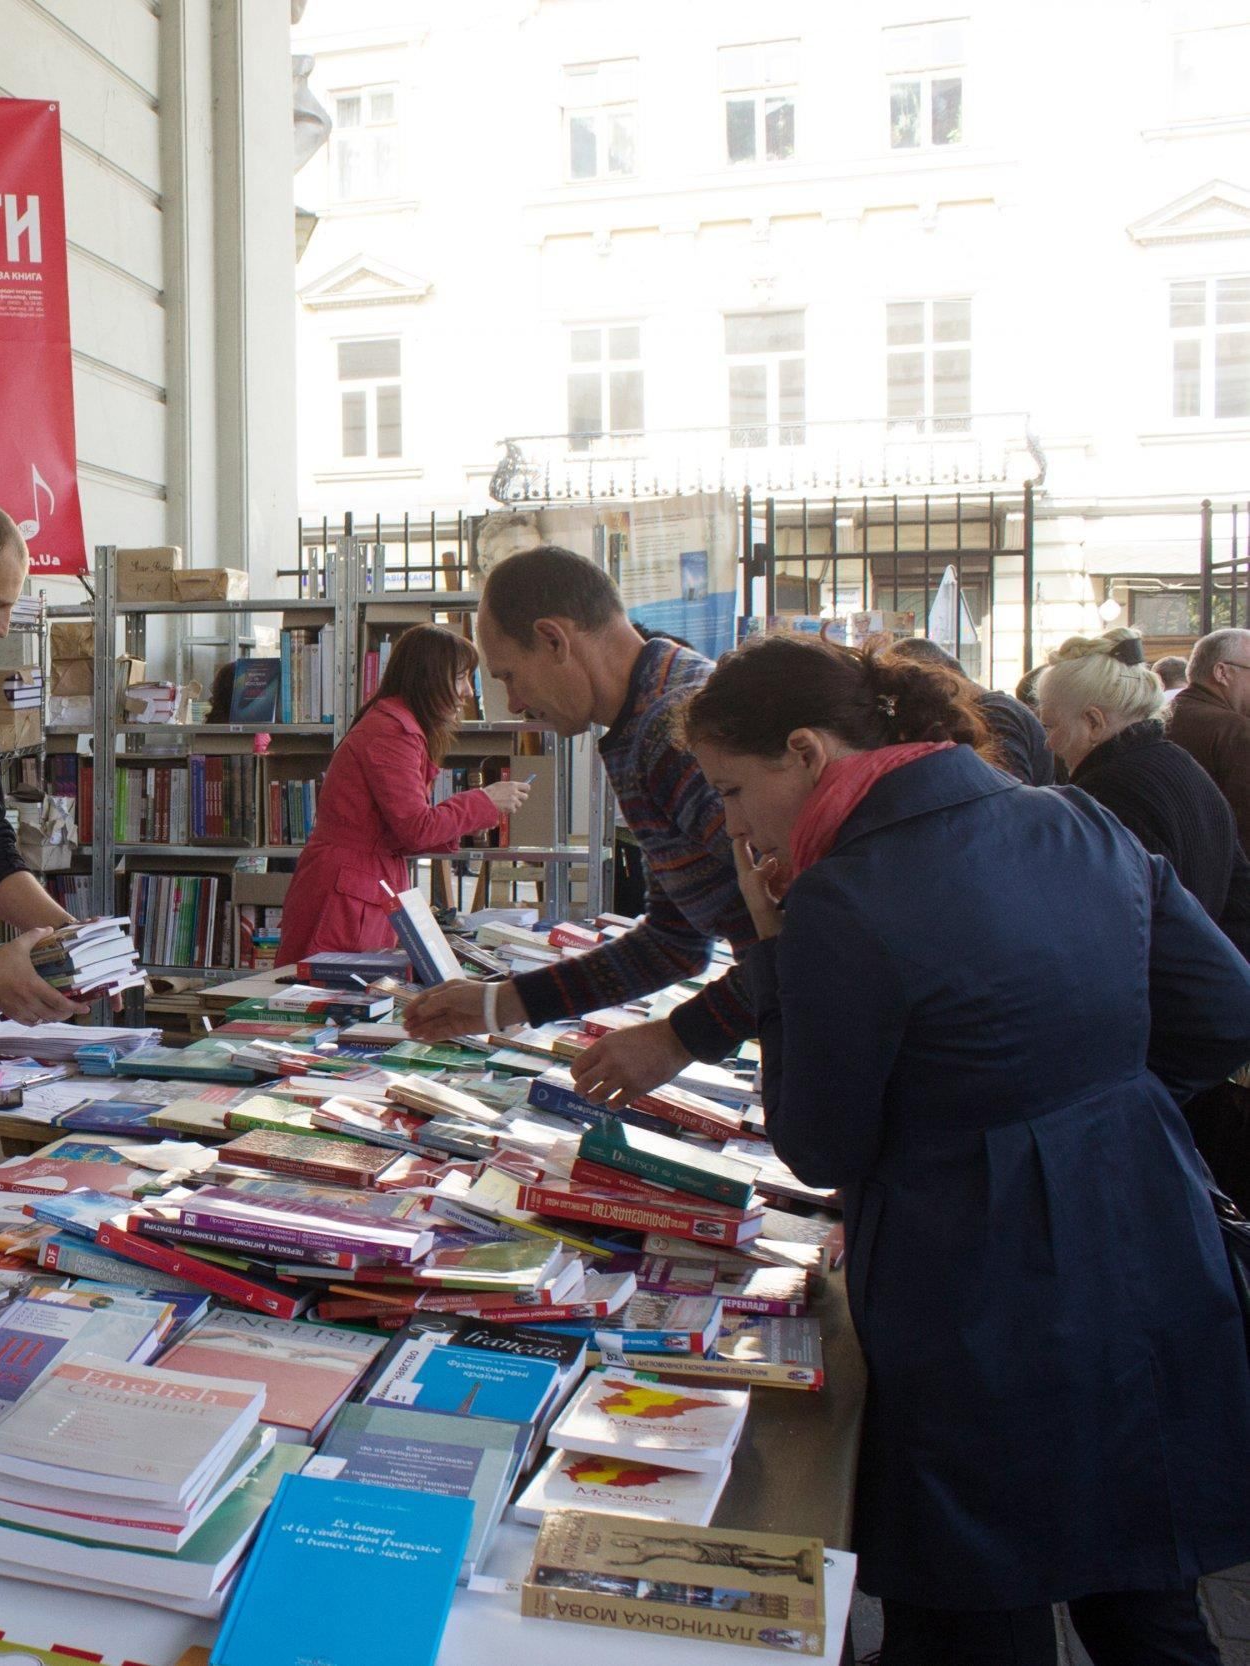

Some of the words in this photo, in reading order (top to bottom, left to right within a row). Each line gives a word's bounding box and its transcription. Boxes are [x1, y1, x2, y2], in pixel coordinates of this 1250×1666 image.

[12, 272, 42, 281] КНИГА
[669, 1107, 698, 1126] Jane
[700, 1118, 730, 1138] Eyre
[11, 1184, 43, 1196] Common
[143, 1221, 182, 1237] ЛІТЕРАТУРИ
[182, 1228, 217, 1242] ТЕХНІЧНОЇ
[217, 1235, 266, 1250] АНГЛОМОВНОЇ
[268, 1244, 305, 1257] ПЕРЕКЛАД
[214, 1312, 374, 1347] ENGLISH
[463, 1330, 568, 1359] français
[446, 1359, 530, 1379] Франкомовні
[462, 1370, 504, 1382] країни
[79, 1369, 219, 1405] English
[67, 1384, 214, 1417] Grammar
[608, 1417, 698, 1433] Мозаїка
[575, 1485, 671, 1505] Мозаїка
[332, 1518, 350, 1529] La
[353, 1522, 396, 1536] langue
[554, 1602, 617, 1624] МОВА
[623, 1609, 755, 1642] ЛАТИНСЬКА
